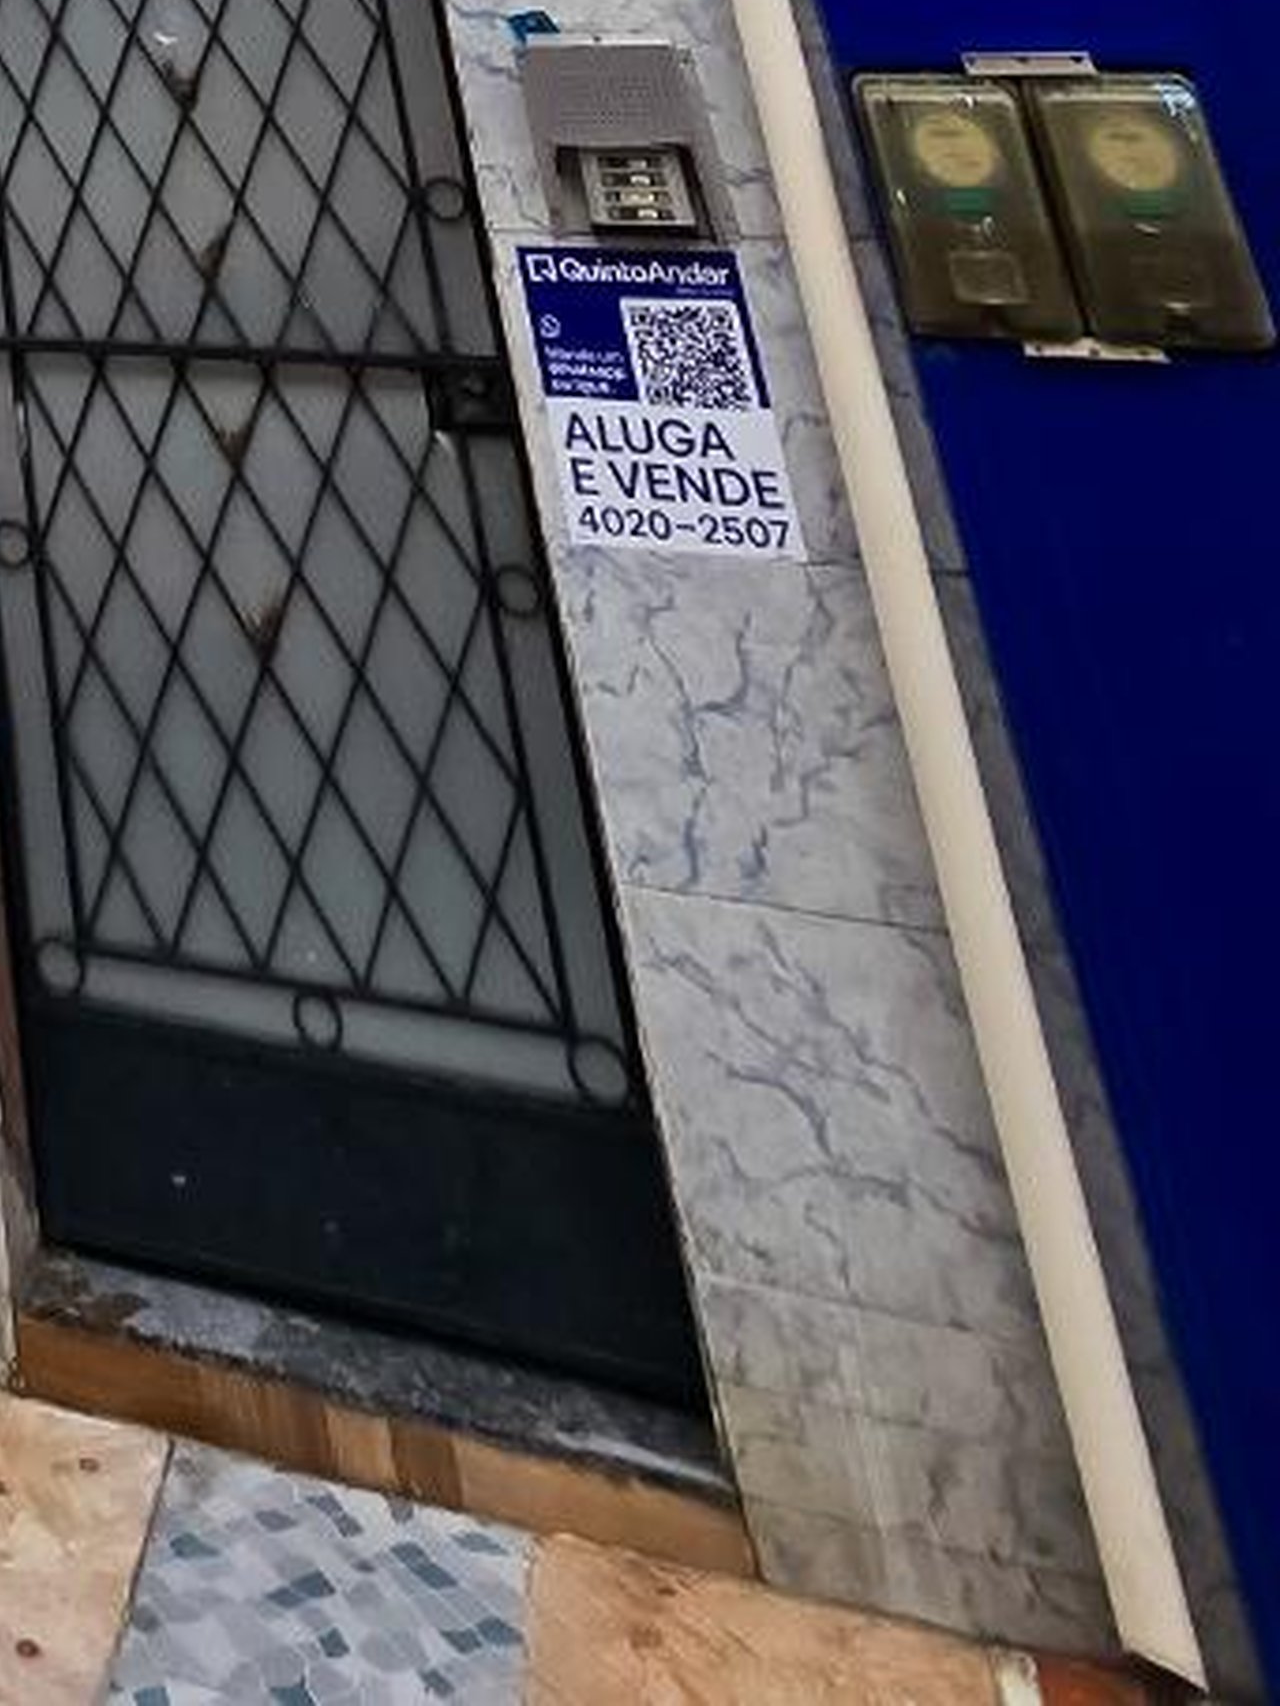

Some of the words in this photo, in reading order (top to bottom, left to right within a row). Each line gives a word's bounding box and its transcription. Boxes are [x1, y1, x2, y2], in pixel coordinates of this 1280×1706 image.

[559, 256, 730, 285] QuintoAndar
[565, 412, 736, 461] ALUGA
[570, 457, 600, 496] E
[607, 460, 785, 509] VENDE
[578, 505, 790, 548] 4020-2507
